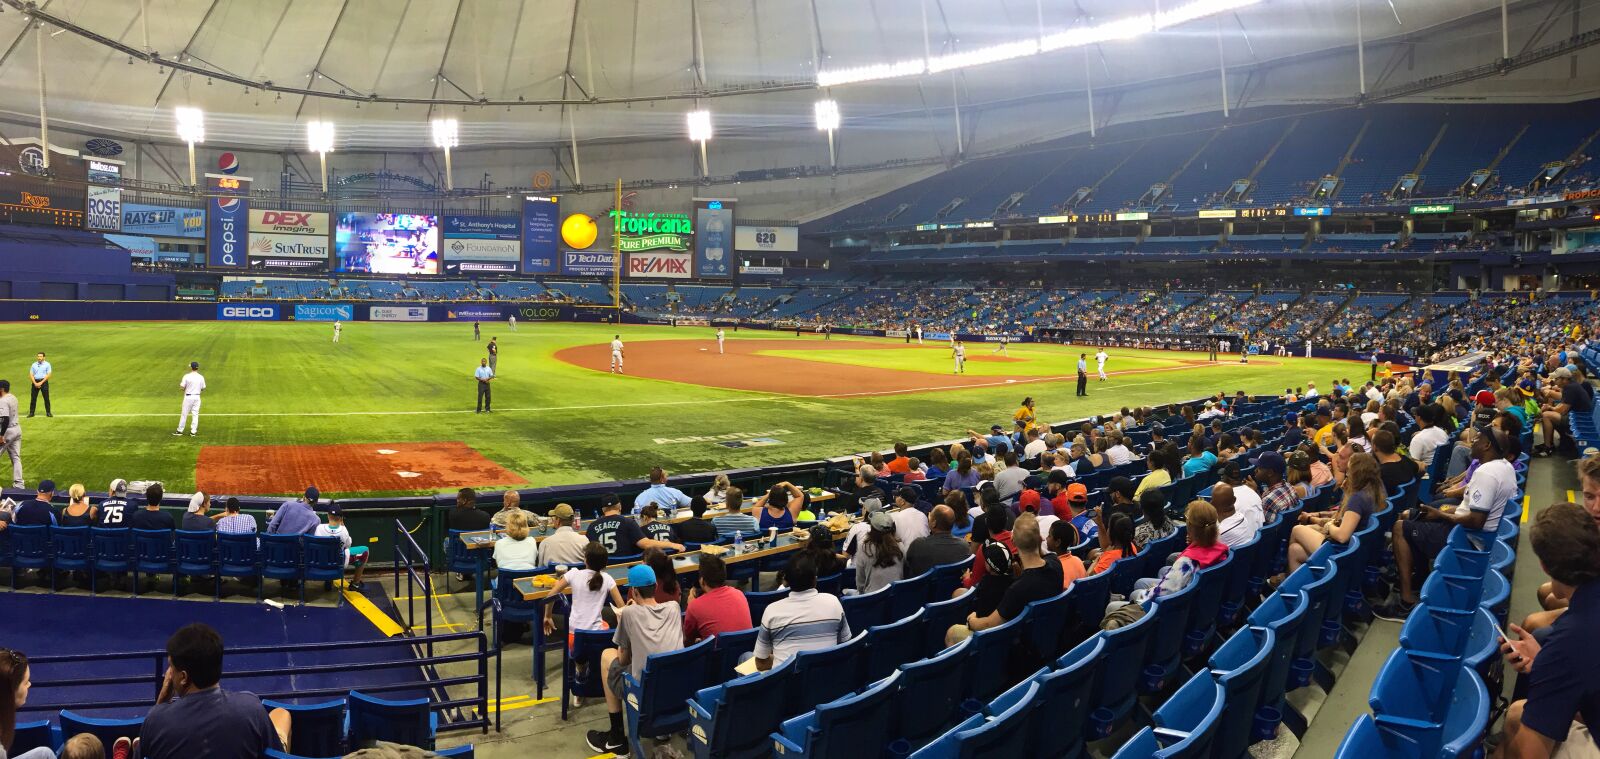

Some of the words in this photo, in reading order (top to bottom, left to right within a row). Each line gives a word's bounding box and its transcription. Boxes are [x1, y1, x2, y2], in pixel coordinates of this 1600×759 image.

[89, 198, 120, 216] ROSE
[88, 214, 120, 230] RADIOLOGY
[124, 211, 156, 225] RAYS
[160, 211, 176, 222] UP
[183, 216, 202, 228] YOU
[262, 211, 312, 226] DEX
[609, 209, 692, 235] Tropicana
[273, 225, 315, 234] imaging
[469, 221, 494, 229] Anthony's
[222, 217, 236, 265] pepsi
[619, 239, 641, 249] PURE
[641, 236, 681, 248] PREMIUM
[756, 233, 776, 243] 620
[467, 243, 515, 252] FOUNDATION
[578, 254, 598, 263] Tech
[630, 257, 688, 273] RE/MAX
[223, 307, 274, 317] GEICO
[297, 304, 336, 315] Sagicor
[520, 308, 559, 317] VOLOGY
[103, 506, 125, 524] 75
[594, 521, 620, 533] SEAGER
[647, 523, 670, 533] SEAGER
[599, 531, 617, 554] 15
